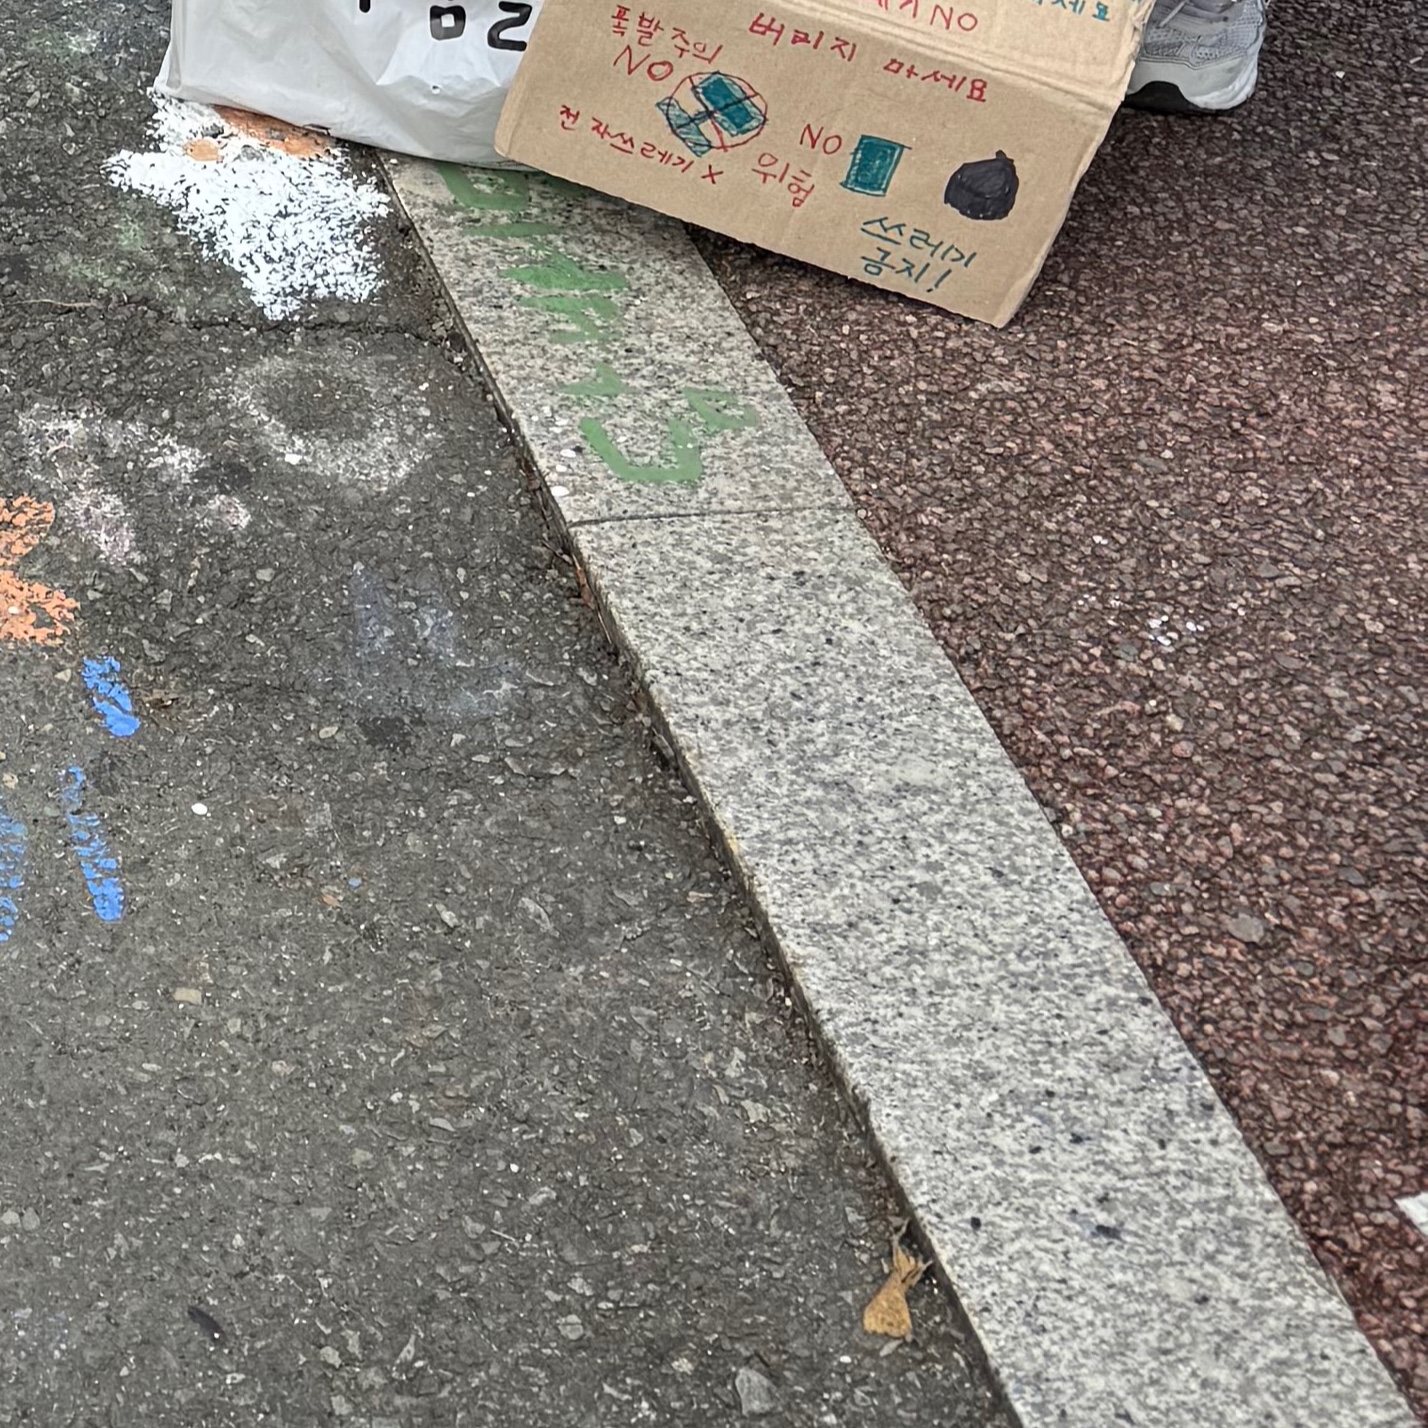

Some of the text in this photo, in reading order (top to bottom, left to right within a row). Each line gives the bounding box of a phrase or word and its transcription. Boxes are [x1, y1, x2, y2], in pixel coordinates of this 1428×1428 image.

[929, 1, 980, 36] NO
[612, 43, 675, 87] NO
[798, 121, 843, 158] NO
[750, 152, 818, 210] 위험
[859, 214, 979, 271] 쓰레기
